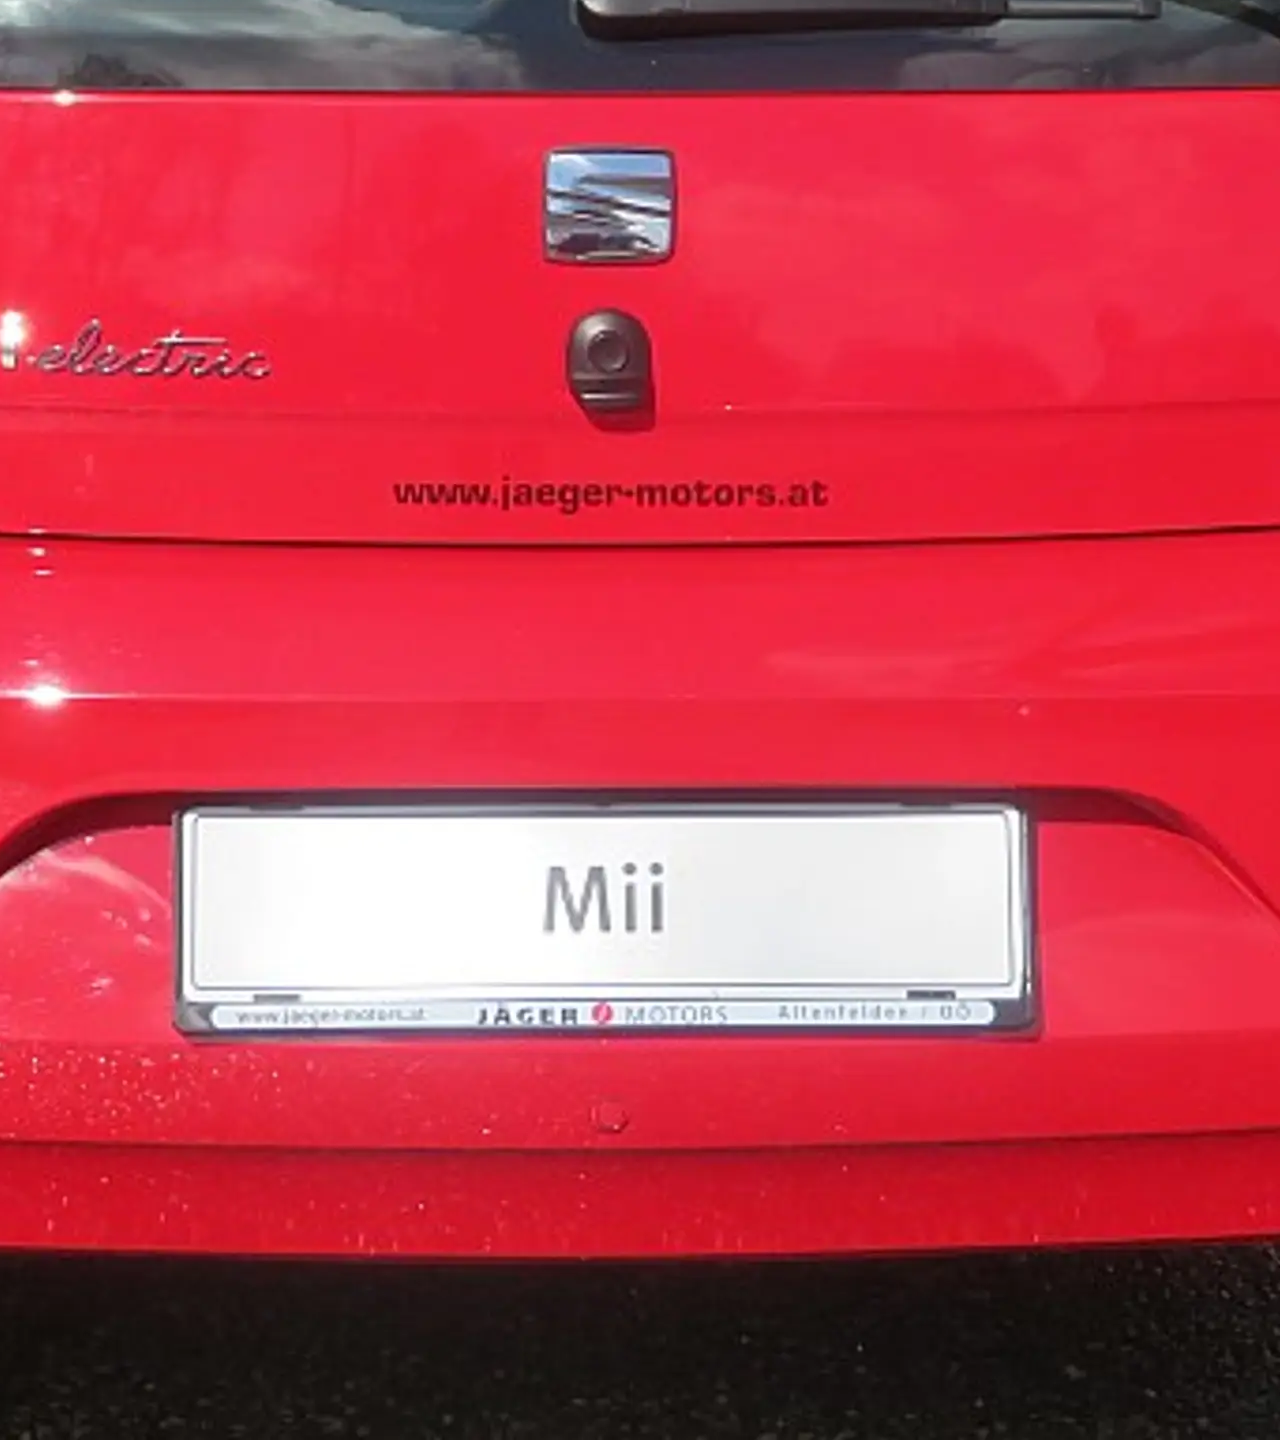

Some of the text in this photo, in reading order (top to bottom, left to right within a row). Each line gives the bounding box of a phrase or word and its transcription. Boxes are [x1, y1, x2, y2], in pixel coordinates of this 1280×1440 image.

[28, 317, 272, 378] electric
[392, 475, 829, 516] www.jaeger-motors.at
[542, 861, 665, 935] Mii
[477, 1003, 729, 1026] JÄGER MOTORS
